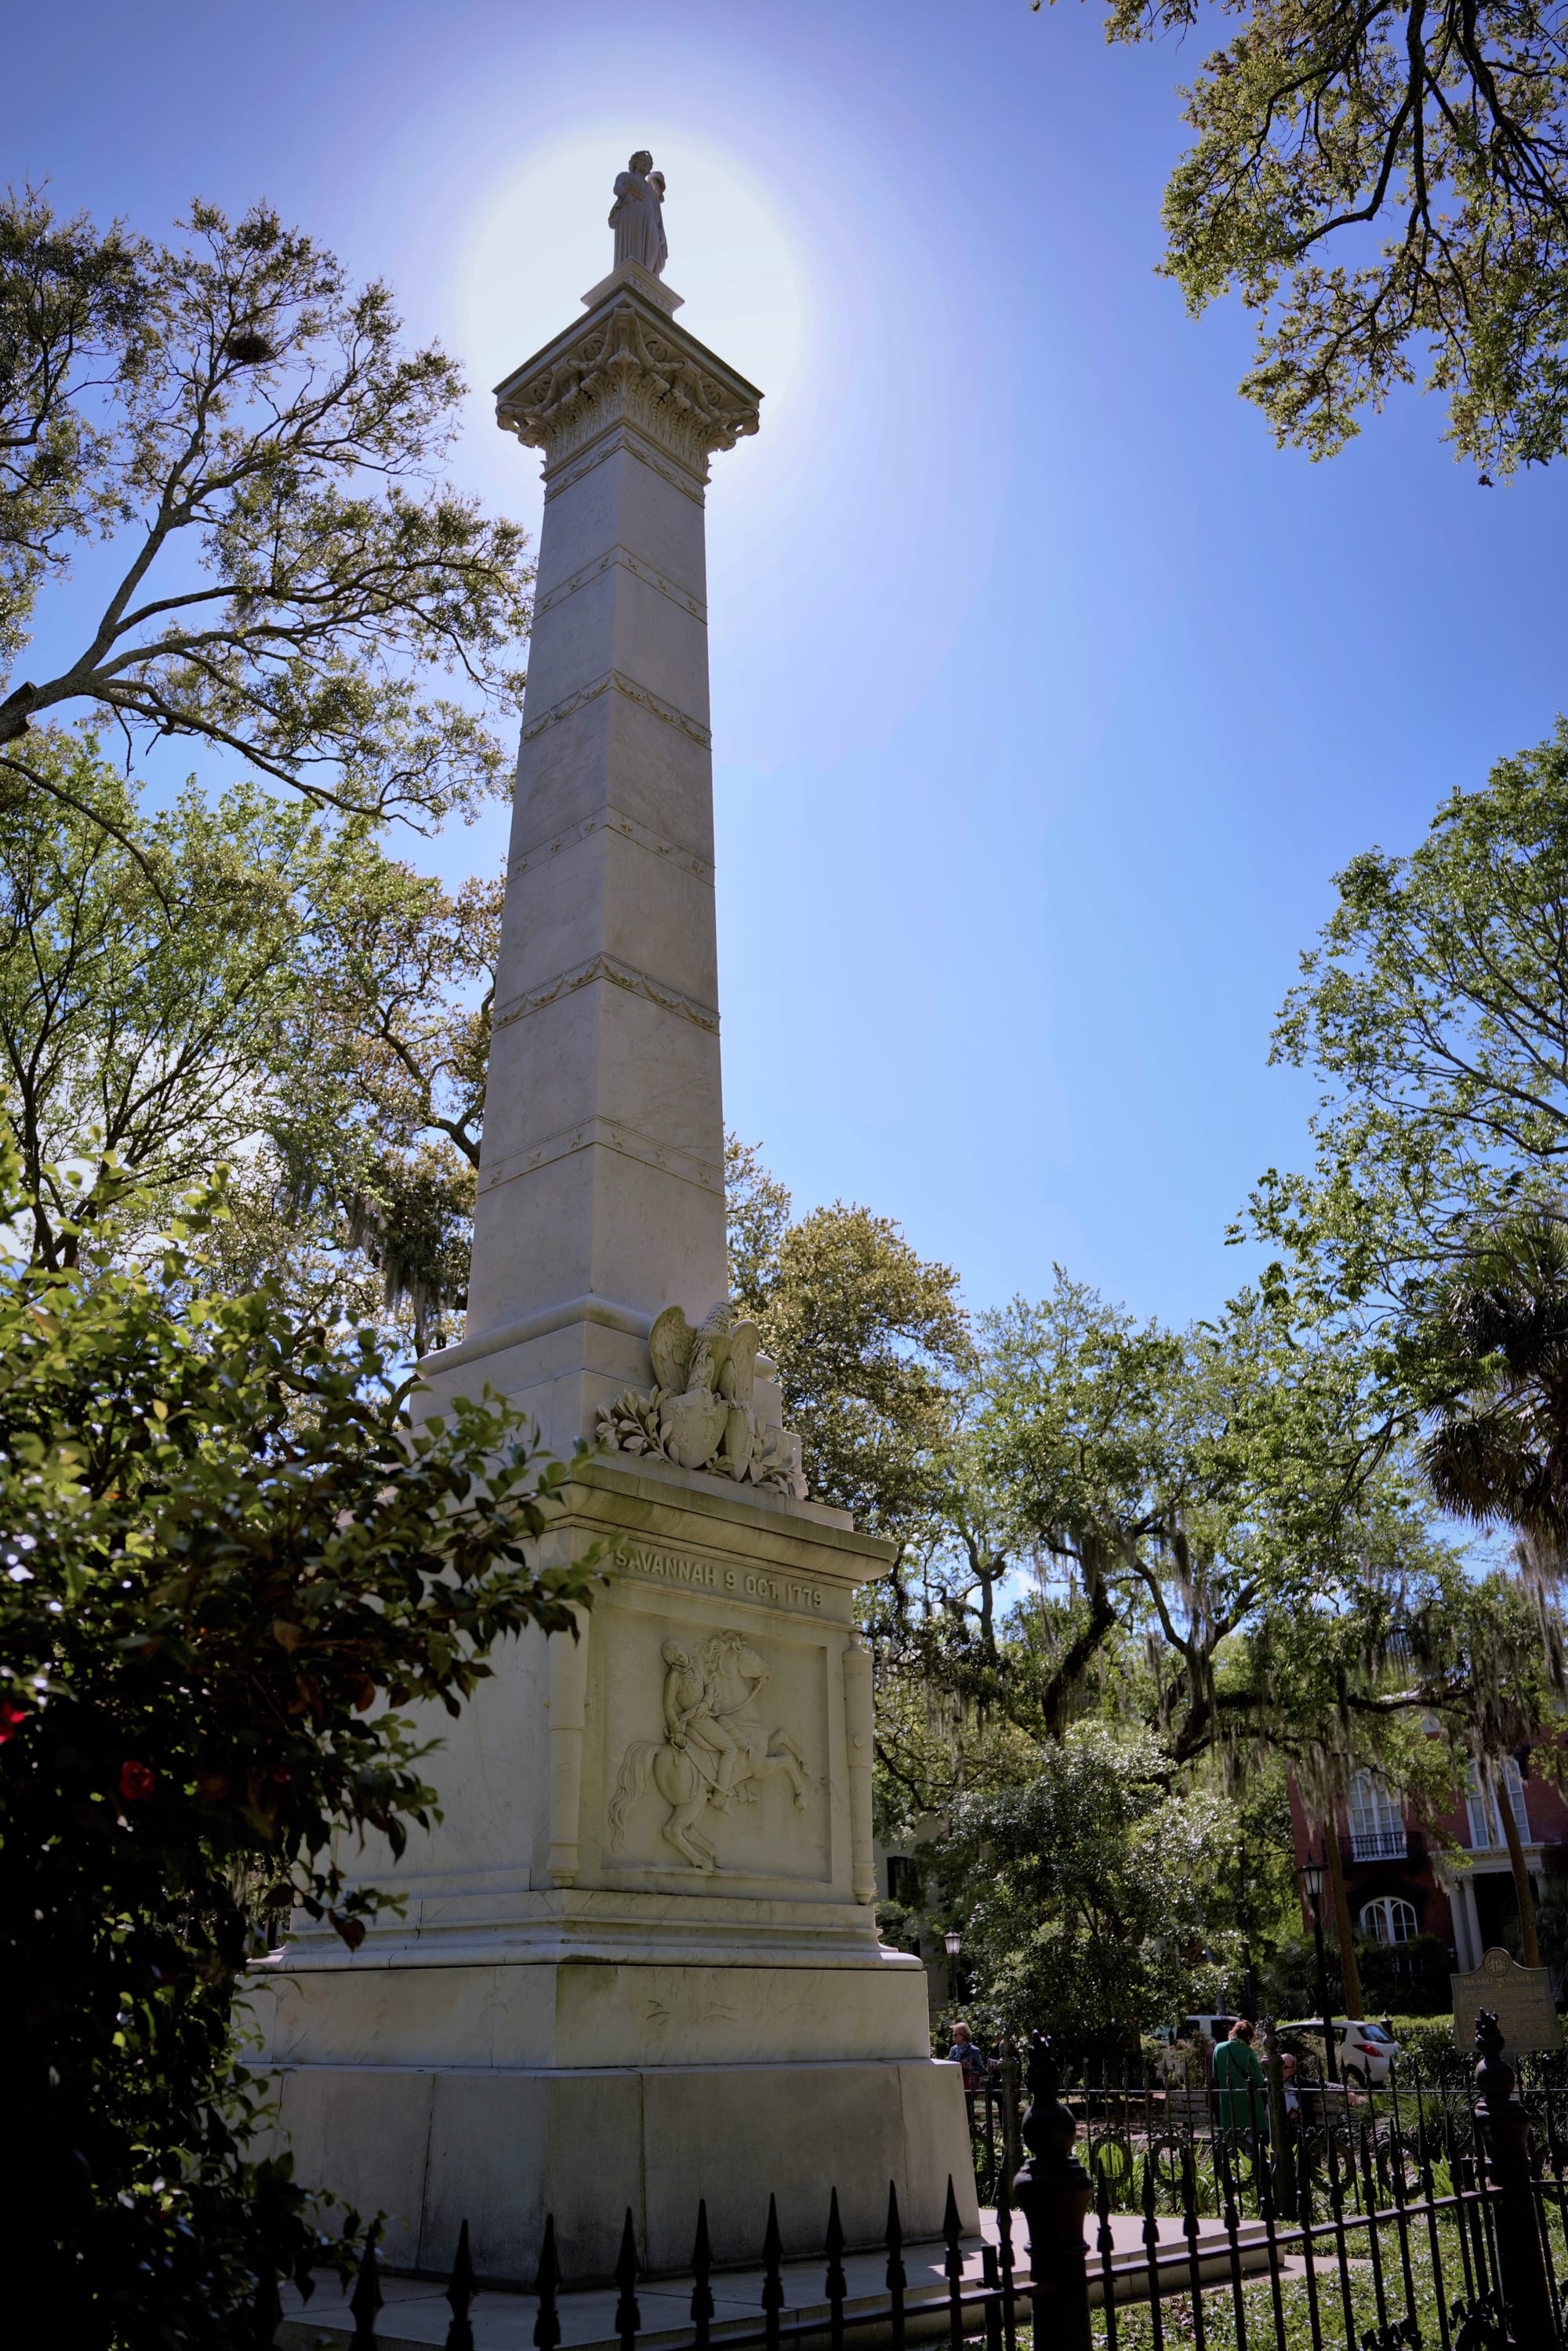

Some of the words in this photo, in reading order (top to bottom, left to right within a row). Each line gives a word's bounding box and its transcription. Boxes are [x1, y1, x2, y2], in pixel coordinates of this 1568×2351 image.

[615, 1547, 716, 1586] SAVANNAH
[725, 1570, 735, 1590] 9
[787, 1583, 822, 1608] 1779
